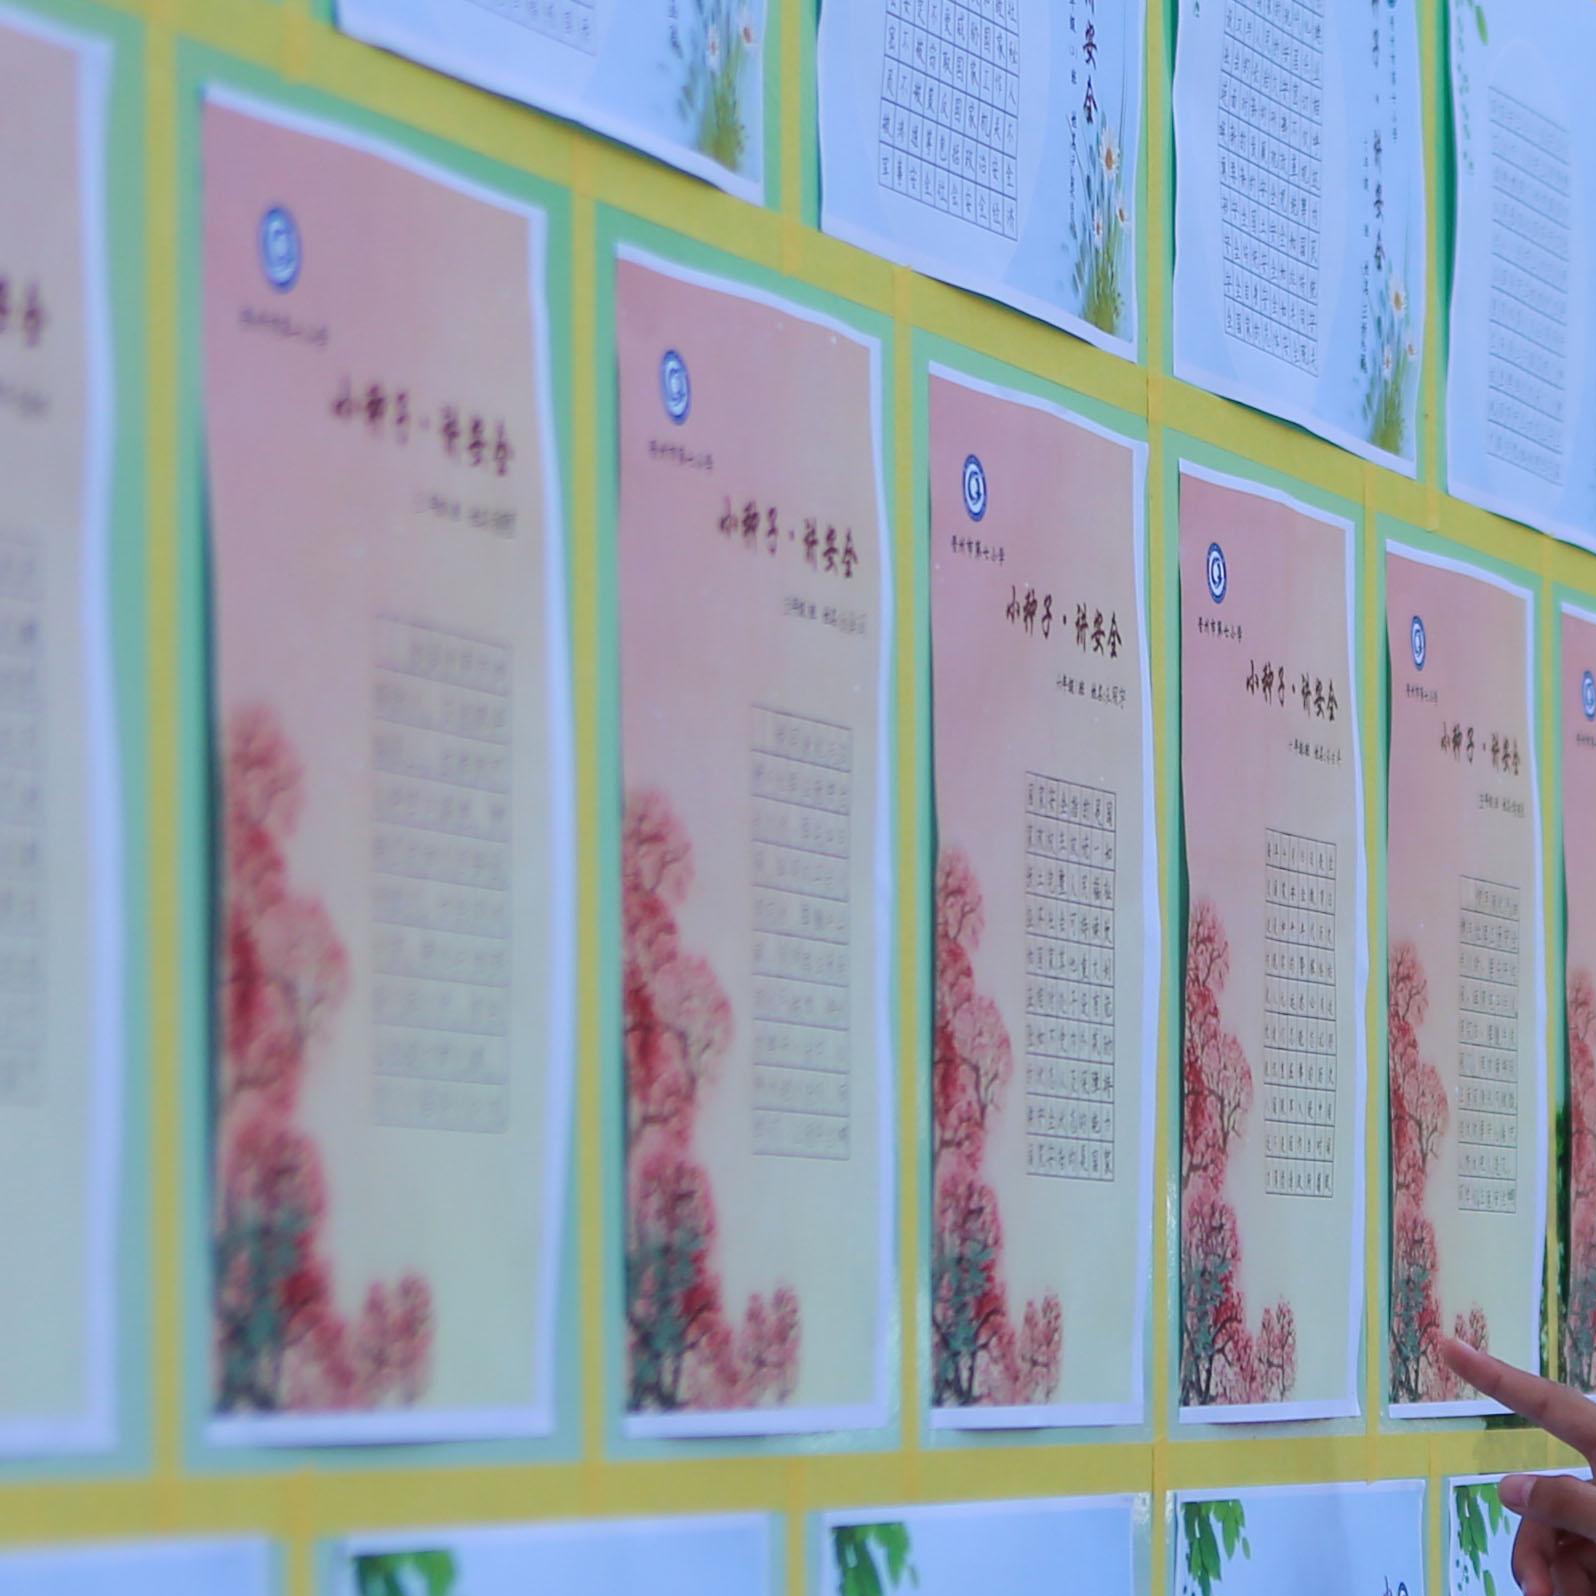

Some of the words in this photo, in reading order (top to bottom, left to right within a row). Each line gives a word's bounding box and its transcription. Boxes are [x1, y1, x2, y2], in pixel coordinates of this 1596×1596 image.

[1005, 585, 1123, 659] 小种子·讲安全
[1245, 659, 1339, 722] 小种子·讲安全
[1439, 720, 1521, 776] 小种子·讲安全
